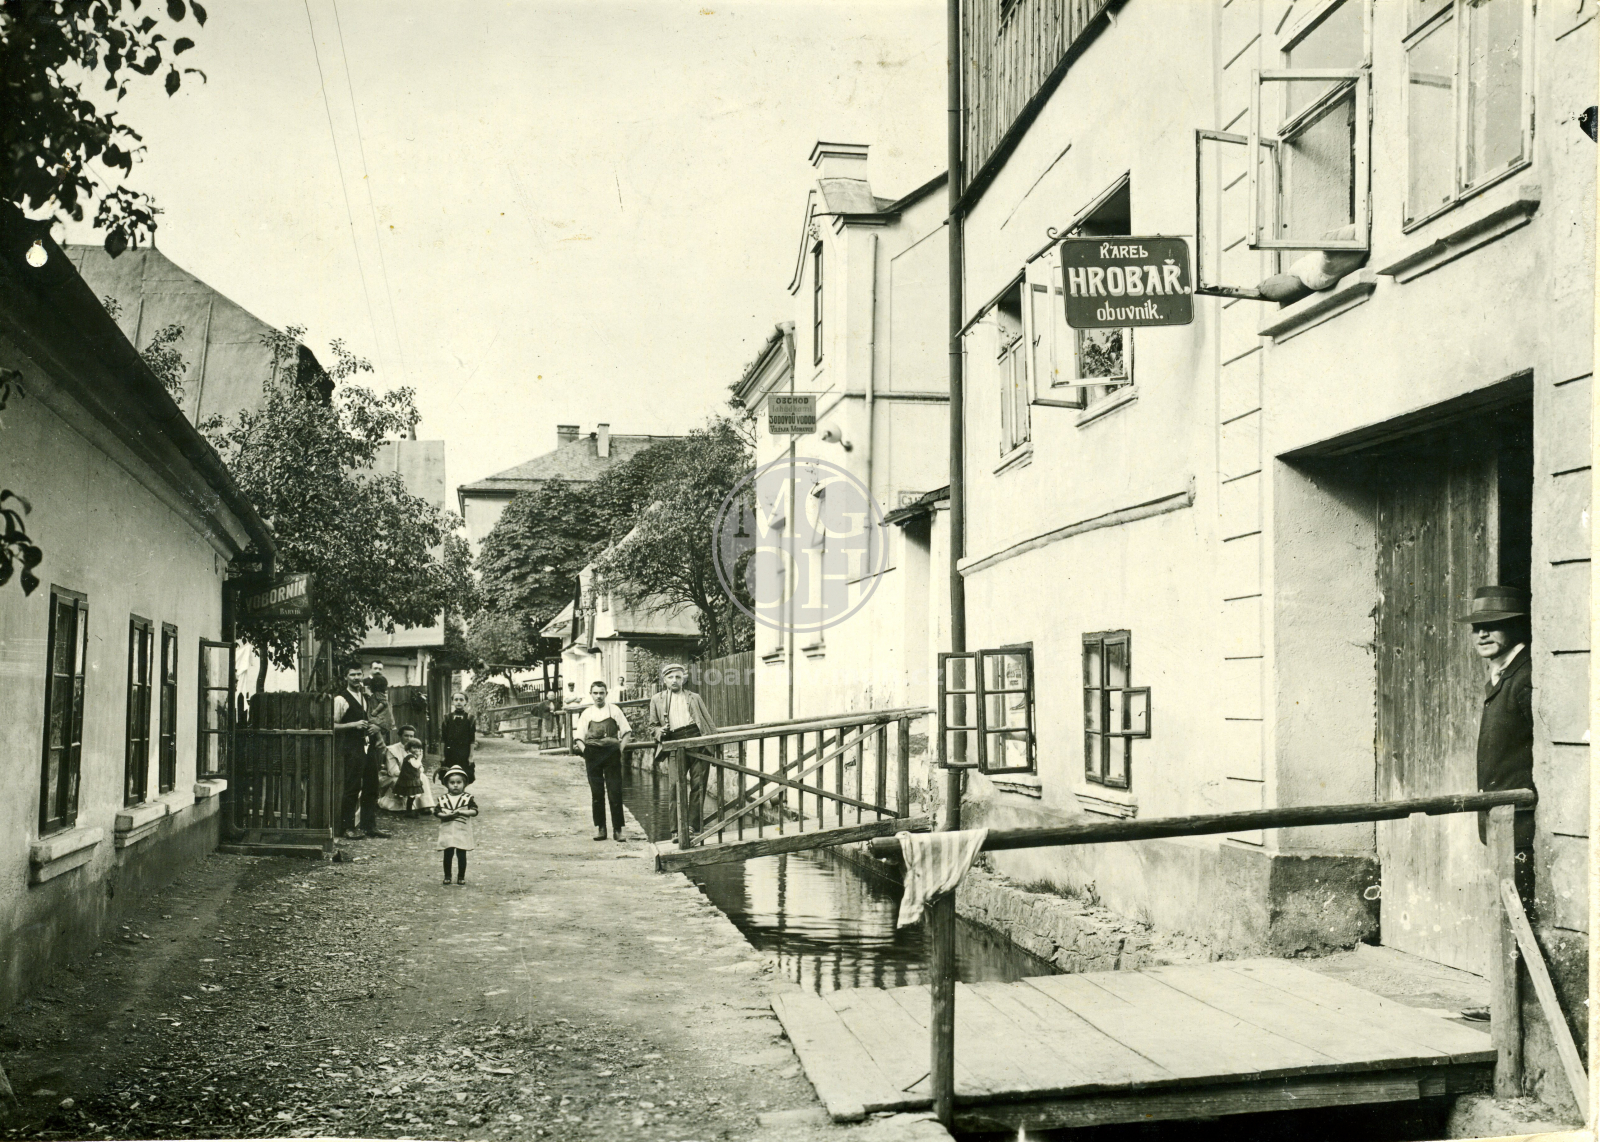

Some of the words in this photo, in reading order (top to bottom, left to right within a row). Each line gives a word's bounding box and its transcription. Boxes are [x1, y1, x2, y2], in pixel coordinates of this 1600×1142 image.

[1099, 242, 1149, 259] KAREL
[1067, 258, 1192, 298] HROBAŘ.
[246, 578, 306, 613] VOBORNÍK
